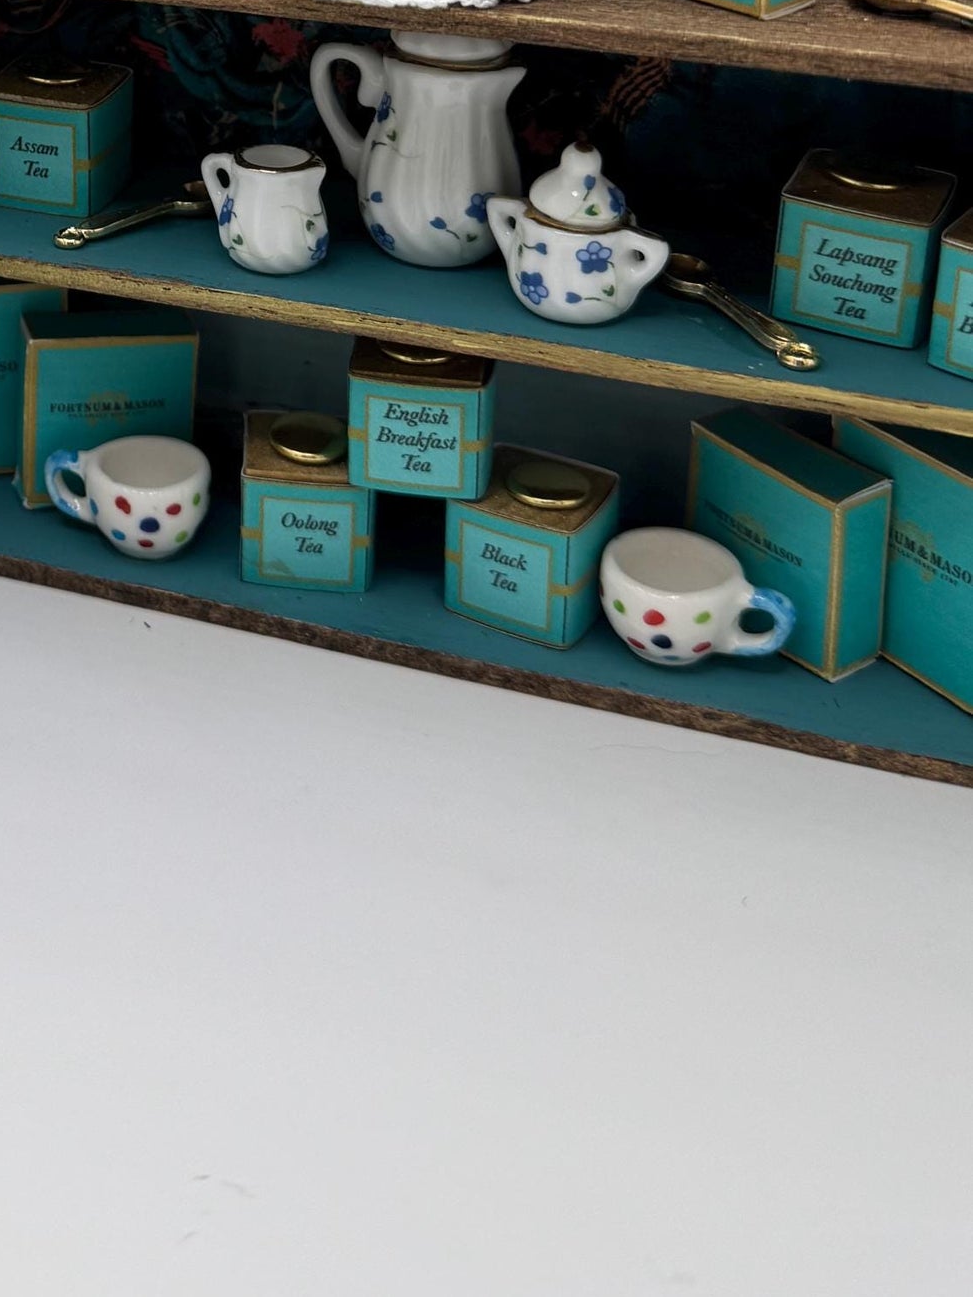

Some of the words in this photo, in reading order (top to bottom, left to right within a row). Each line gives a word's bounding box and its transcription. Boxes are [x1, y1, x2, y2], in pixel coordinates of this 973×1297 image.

[10, 136, 58, 156] Assam
[24, 160, 49, 178] Tea
[813, 238, 898, 276] Lapsang
[809, 264, 897, 303] Souchong
[834, 296, 866, 319] Tea
[383, 403, 449, 427] English
[376, 425, 457, 452] Breakfast
[401, 453, 431, 472] Tea
[281, 511, 338, 535] Oolong
[295, 536, 323, 553] Tea
[481, 543, 527, 570] Black
[489, 569, 517, 592] Tea
